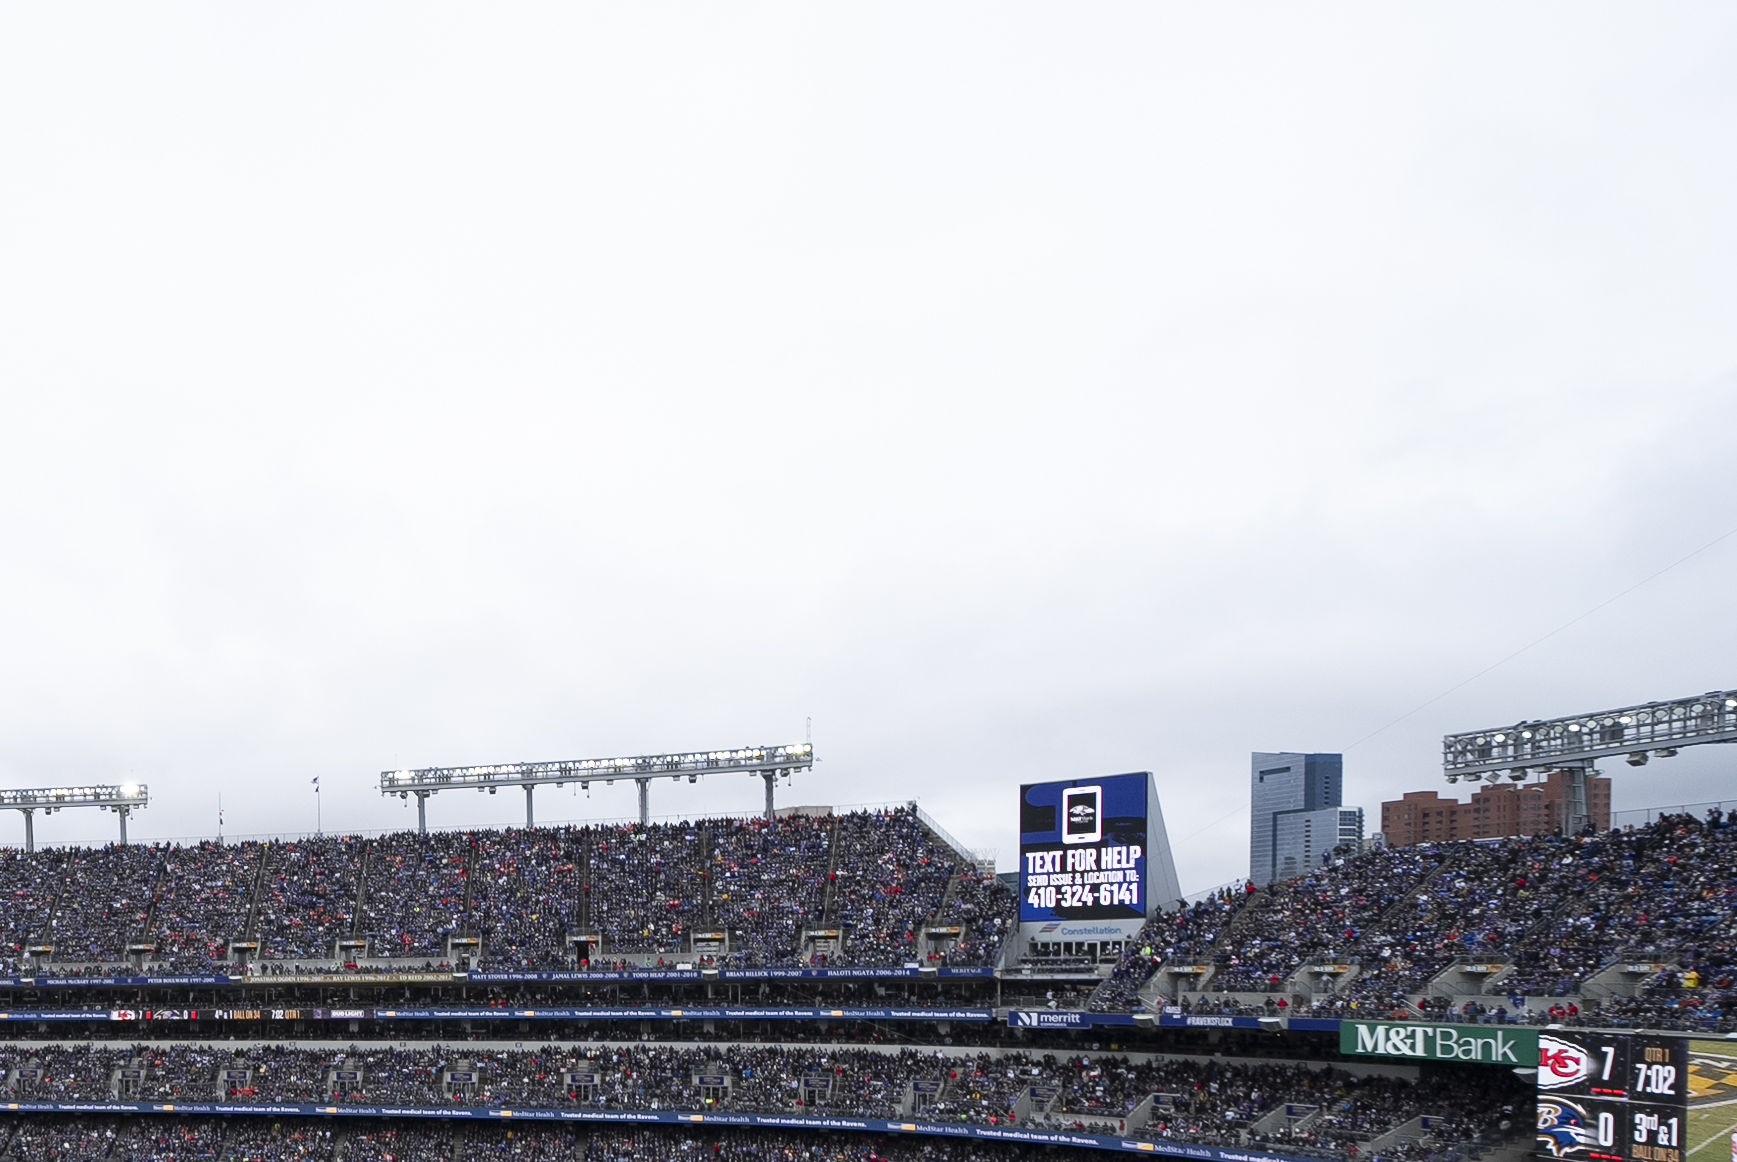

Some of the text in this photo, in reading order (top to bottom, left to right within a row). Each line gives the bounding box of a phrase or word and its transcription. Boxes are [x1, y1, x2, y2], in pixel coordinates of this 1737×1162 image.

[1025, 845, 1142, 873] TEXT FOR HELP
[1027, 870, 1140, 887] SEND ISSUE & LOCATION TO:
[1027, 882, 1139, 908] 410-324-6141
[1061, 926, 1122, 936] Constellation
[769, 970, 803, 978] 1999-2007
[271, 1010, 284, 1019] 7:02
[1040, 1013, 1081, 1023] merritt
[1186, 1016, 1233, 1026] #RAVENSFLOCK
[1354, 1023, 1519, 1062] M&T Bank
[1644, 1047, 1671, 1063] QTR 1
[1601, 1046, 1615, 1081] 7
[1635, 1063, 1676, 1096] 7:02
[728, 1115, 750, 1123] Health
[756, 1116, 780, 1124] Trusted
[780, 1117, 805, 1125] medical
[805, 1118, 822, 1126] team
[916, 1124, 969, 1134] MedStar Health
[975, 1128, 1002, 1137] Trusted
[1003, 1130, 1030, 1139] medical
[1031, 1133, 1049, 1141] team
[1598, 1112, 1614, 1147] 0
[1154, 1143, 1212, 1158] MedStar Health
[1218, 1151, 1248, 1162] Trusted
[1631, 1144, 1653, 1161] BALL
[1653, 1147, 1667, 1162] ON
